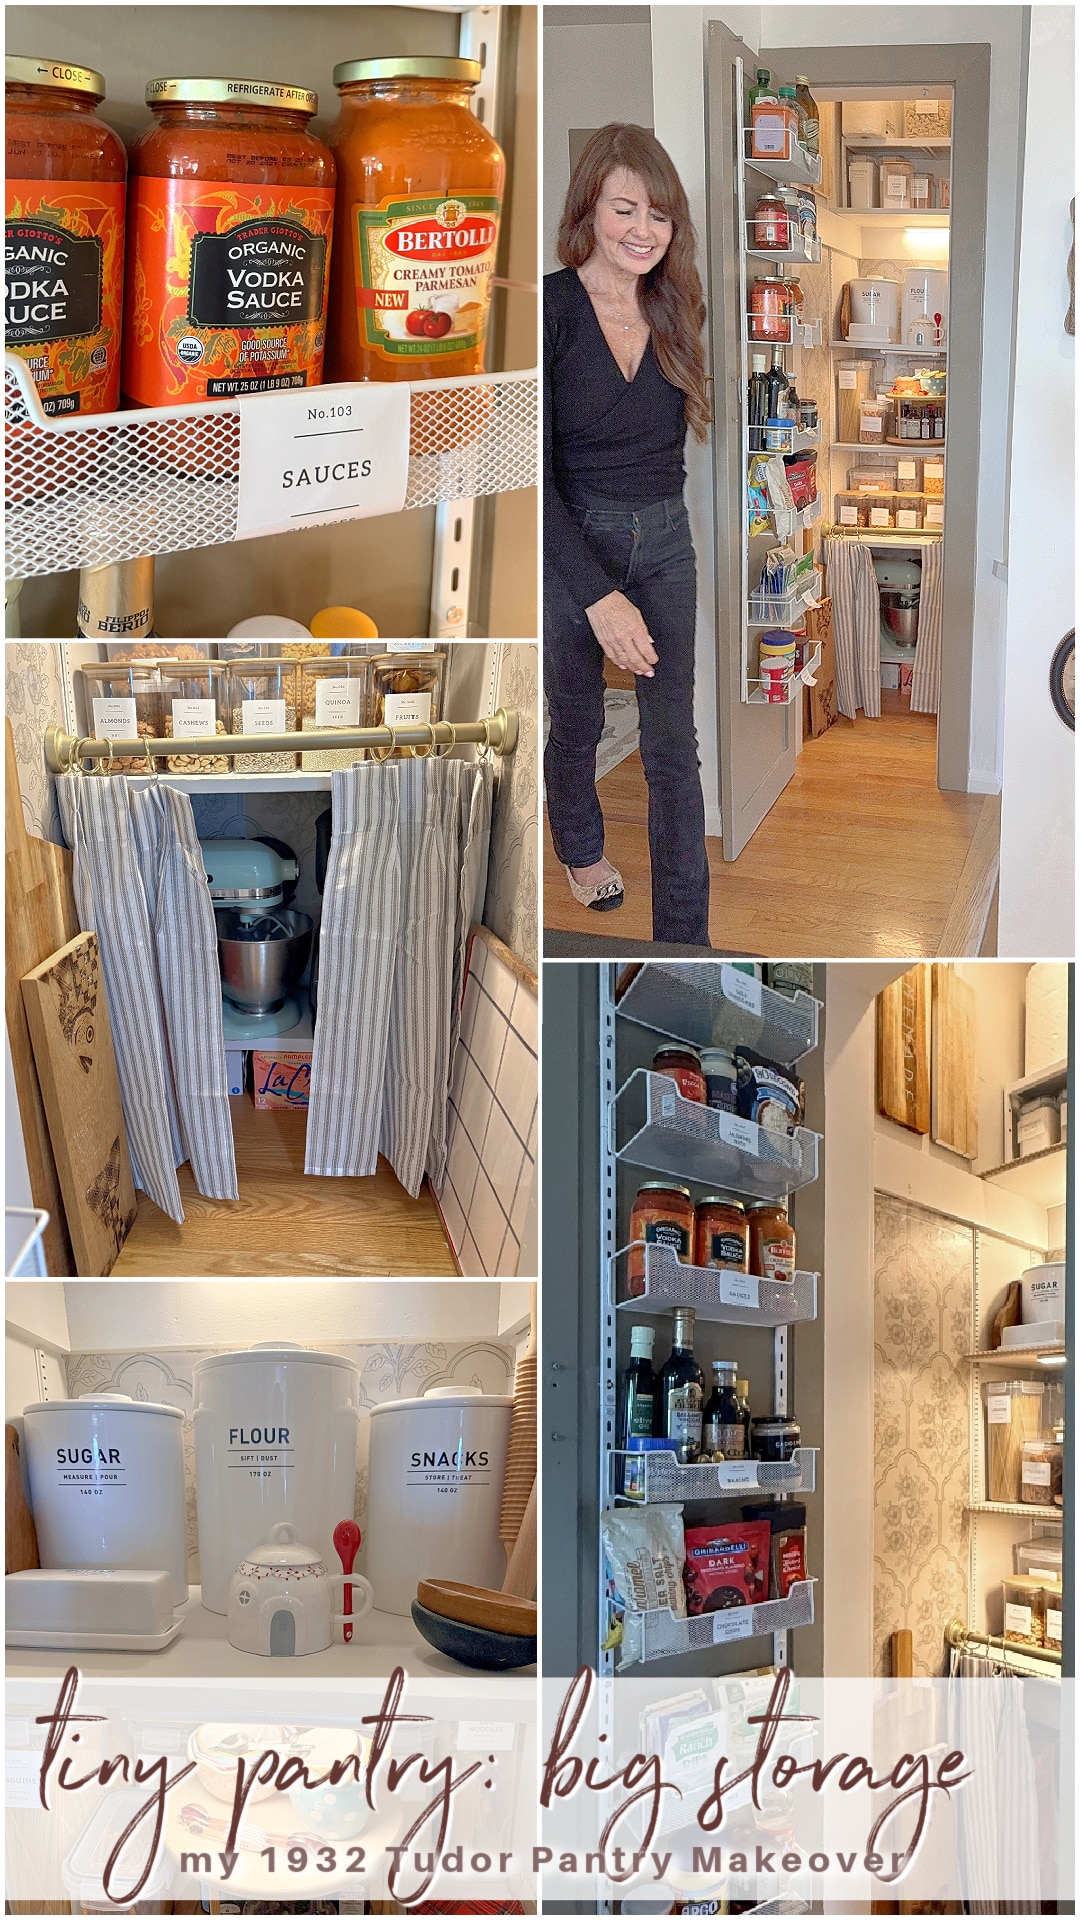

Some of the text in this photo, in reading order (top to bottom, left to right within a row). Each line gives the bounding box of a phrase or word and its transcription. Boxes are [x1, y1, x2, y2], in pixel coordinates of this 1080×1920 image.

[52, 66, 83, 83] CLOSE
[150, 81, 168, 93] CLOSE
[227, 83, 284, 98] REFRIGERATE
[286, 89, 305, 102] AFTER
[406, 203, 434, 213] SINCE
[17, 229, 63, 245] GIOTTO'S
[236, 227, 304, 242] TRADER GIOTTO'S
[397, 226, 494, 252] BERTOLLI
[5, 246, 69, 266] GANIC
[228, 241, 306, 260] ORGANIC
[227, 269, 305, 288] VODKA
[393, 261, 491, 281] CREAMY TOMATO
[415, 276, 477, 292] PARMESAN
[227, 290, 302, 309] SAUCE
[374, 293, 405, 307] NEW
[241, 337, 287, 350] GOOD SOURCE
[239, 352, 249, 362] OF
[212, 382, 226, 393] NET
[227, 381, 240, 393] WT.
[240, 380, 249, 391] 25
[250, 380, 259, 390] OZ
[267, 379, 275, 389] LB
[275, 378, 280, 388] 9
[58, 397, 75, 410] 709g
[307, 405, 353, 420] No.103
[282, 459, 372, 489] SAUCES
[97, 612, 149, 633] BERIO
[105, 609, 146, 623] FILIPPO
[178, 719, 209, 727] CASHEWS
[1031, 1281, 1058, 1291] SUGAR
[229, 1427, 290, 1445] FLOUR
[56, 1448, 121, 1464] SUGAR
[411, 1451, 489, 1467] SNACKS
[708, 1556, 735, 1568] DARK
[679, 1735, 714, 1755] Ranch
[5, 1777, 37, 1785] NGUINE
